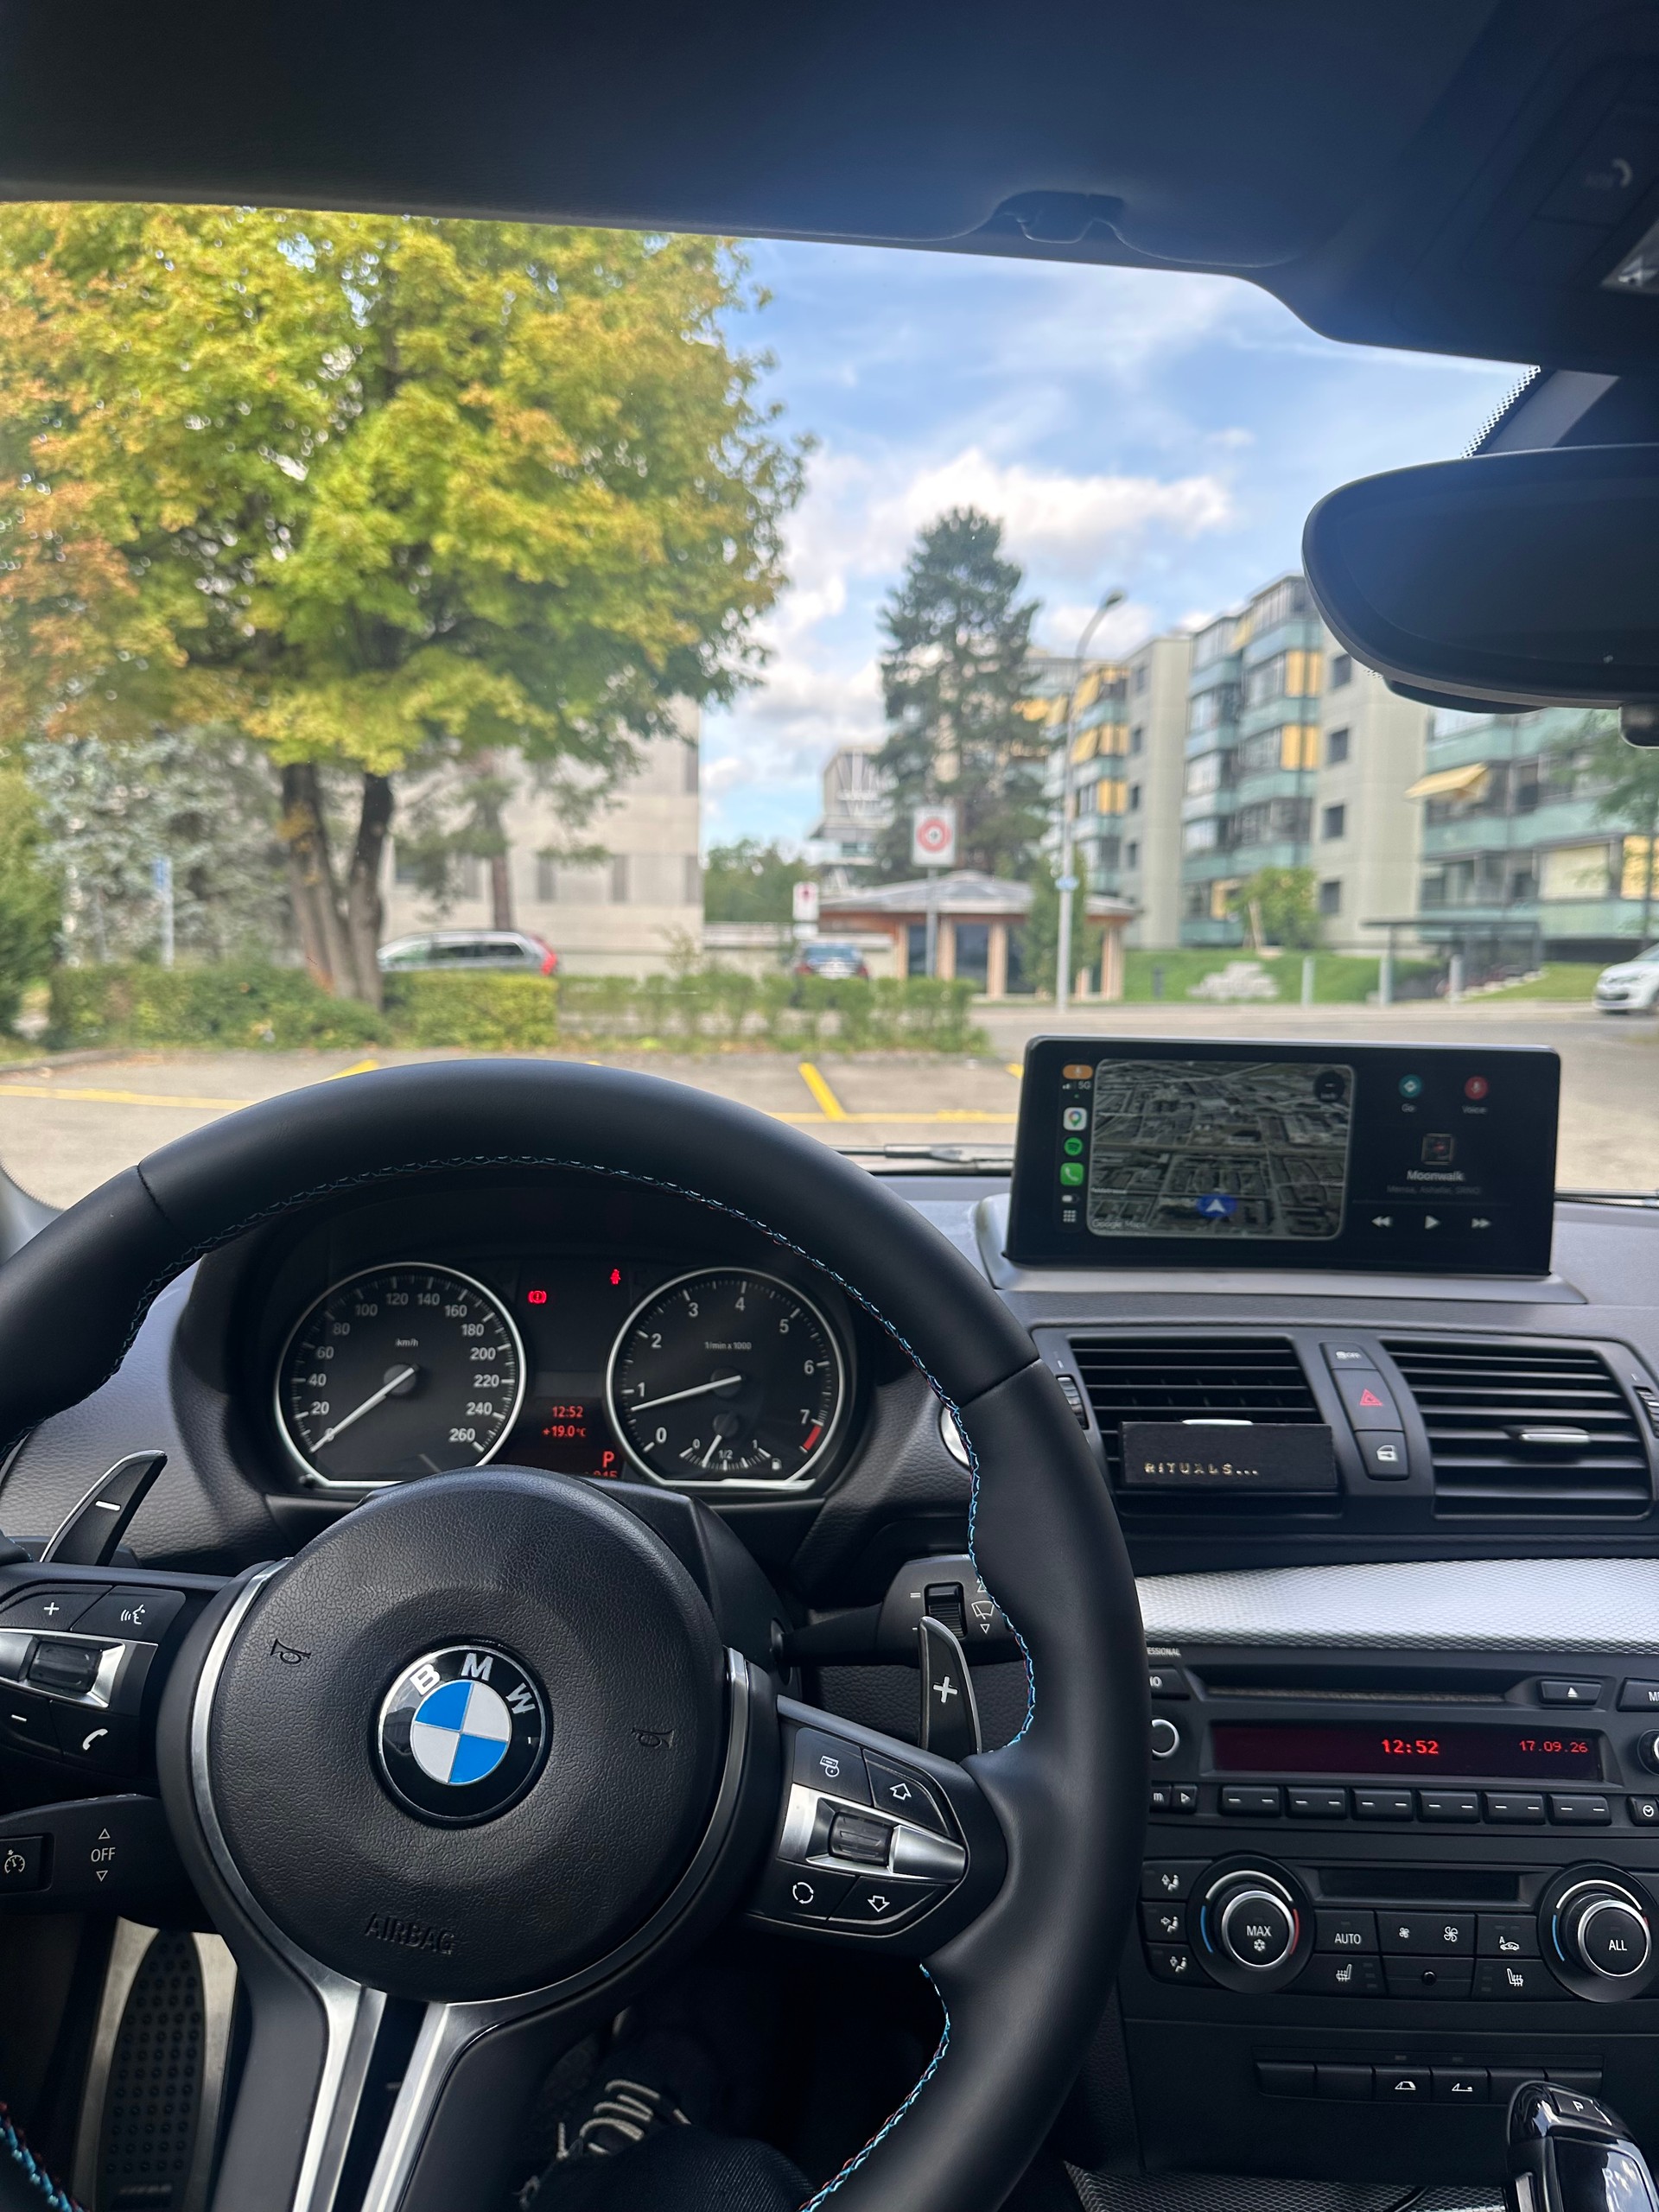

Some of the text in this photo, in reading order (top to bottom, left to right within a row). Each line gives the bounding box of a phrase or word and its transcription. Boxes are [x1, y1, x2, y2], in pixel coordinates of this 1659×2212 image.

[1462, 1105, 1487, 1115] Voice
[1407, 1170, 1465, 1182] Moonwalk
[1092, 1219, 1147, 1229] Google Maps
[386, 1293, 409, 1306] 120
[417, 1294, 440, 1306] 140
[735, 1297, 745, 1311] 4
[355, 1304, 378, 1317] 100
[445, 1305, 467, 1317] 160
[689, 1302, 699, 1317] 3
[333, 1323, 350, 1335] 80
[461, 1323, 484, 1336] 180
[779, 1319, 789, 1333] 5
[396, 1338, 419, 1347] km/h
[652, 1333, 662, 1348] 2
[316, 1347, 334, 1359] 60
[470, 1347, 496, 1360] 200
[804, 1360, 814, 1374] 6
[308, 1373, 327, 1386] 40
[474, 1374, 499, 1387] 220
[638, 1382, 645, 1396] 1
[311, 1402, 329, 1414] 20
[466, 1402, 493, 1415] 240
[552, 1406, 583, 1418] 12:52
[800, 1409, 810, 1424] 7
[449, 1428, 476, 1441] 260
[656, 1427, 667, 1443] 0
[693, 1439, 701, 1449] 0
[753, 1440, 758, 1449] 1
[602, 1451, 614, 1468] P
[719, 1449, 734, 1459] 1/2
[410, 1653, 536, 1714] BMW
[1382, 1739, 1439, 1754] 12:52
[1519, 1740, 1588, 1753] 17.09.26
[91, 1847, 116, 1862] OFF
[365, 1913, 455, 1955] AIRBAG
[1246, 1925, 1272, 1936] MAX
[1335, 1934, 1362, 1944] AUTO
[1608, 1940, 1628, 1951] ALL
[1573, 2101, 1584, 2112] P
